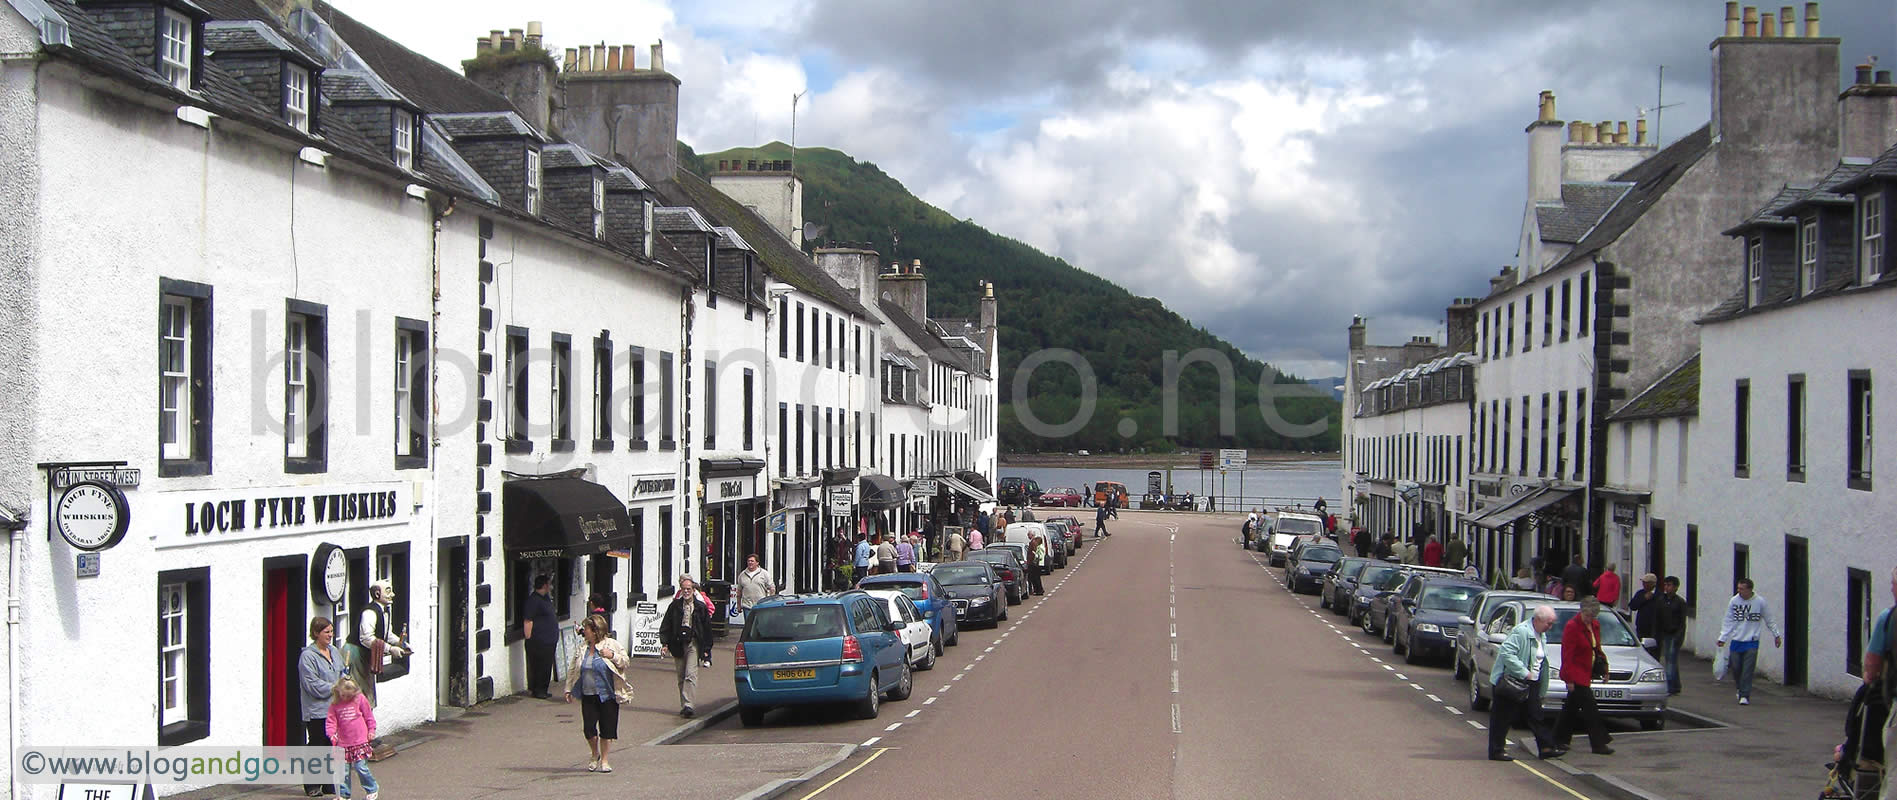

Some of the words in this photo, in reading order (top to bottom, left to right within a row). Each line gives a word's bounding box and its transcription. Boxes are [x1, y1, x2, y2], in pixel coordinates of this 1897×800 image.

[117, 471, 138, 485] WEST
[64, 489, 86, 510] LOCH
[91, 489, 113, 510] FYNE
[63, 513, 114, 521] WHISKIES
[185, 499, 246, 537] LOCH
[254, 497, 306, 529] FYNE
[313, 490, 397, 524] WHISKIES
[635, 631, 660, 639] SCOTTIS
[640, 638, 657, 646] SOAP
[634, 645, 661, 653] COMPANY
[85, 790, 111, 800] THE
